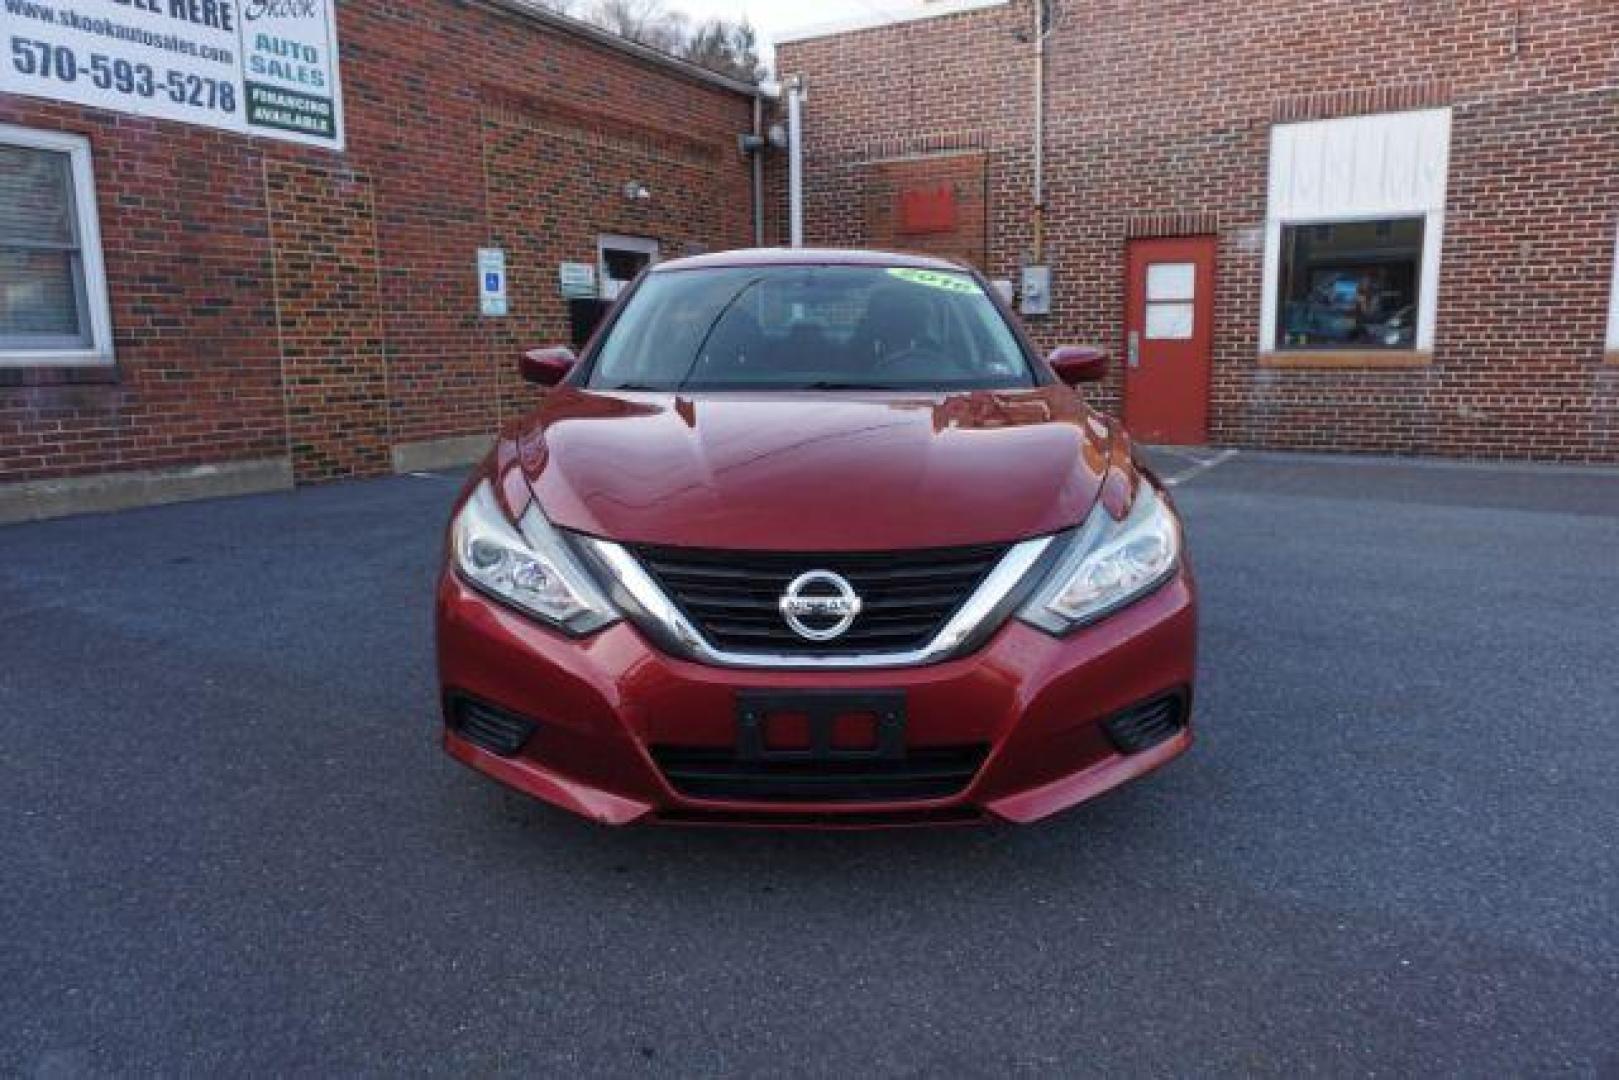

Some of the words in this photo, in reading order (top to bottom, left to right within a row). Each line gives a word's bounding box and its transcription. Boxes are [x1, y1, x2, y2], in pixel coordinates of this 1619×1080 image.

[169, 0, 234, 31] HERE
[4, 0, 234, 64] www.skookautosales.com
[255, 33, 318, 64] AUTO
[10, 35, 237, 112] 570-593-5278
[249, 55, 325, 87] SALES
